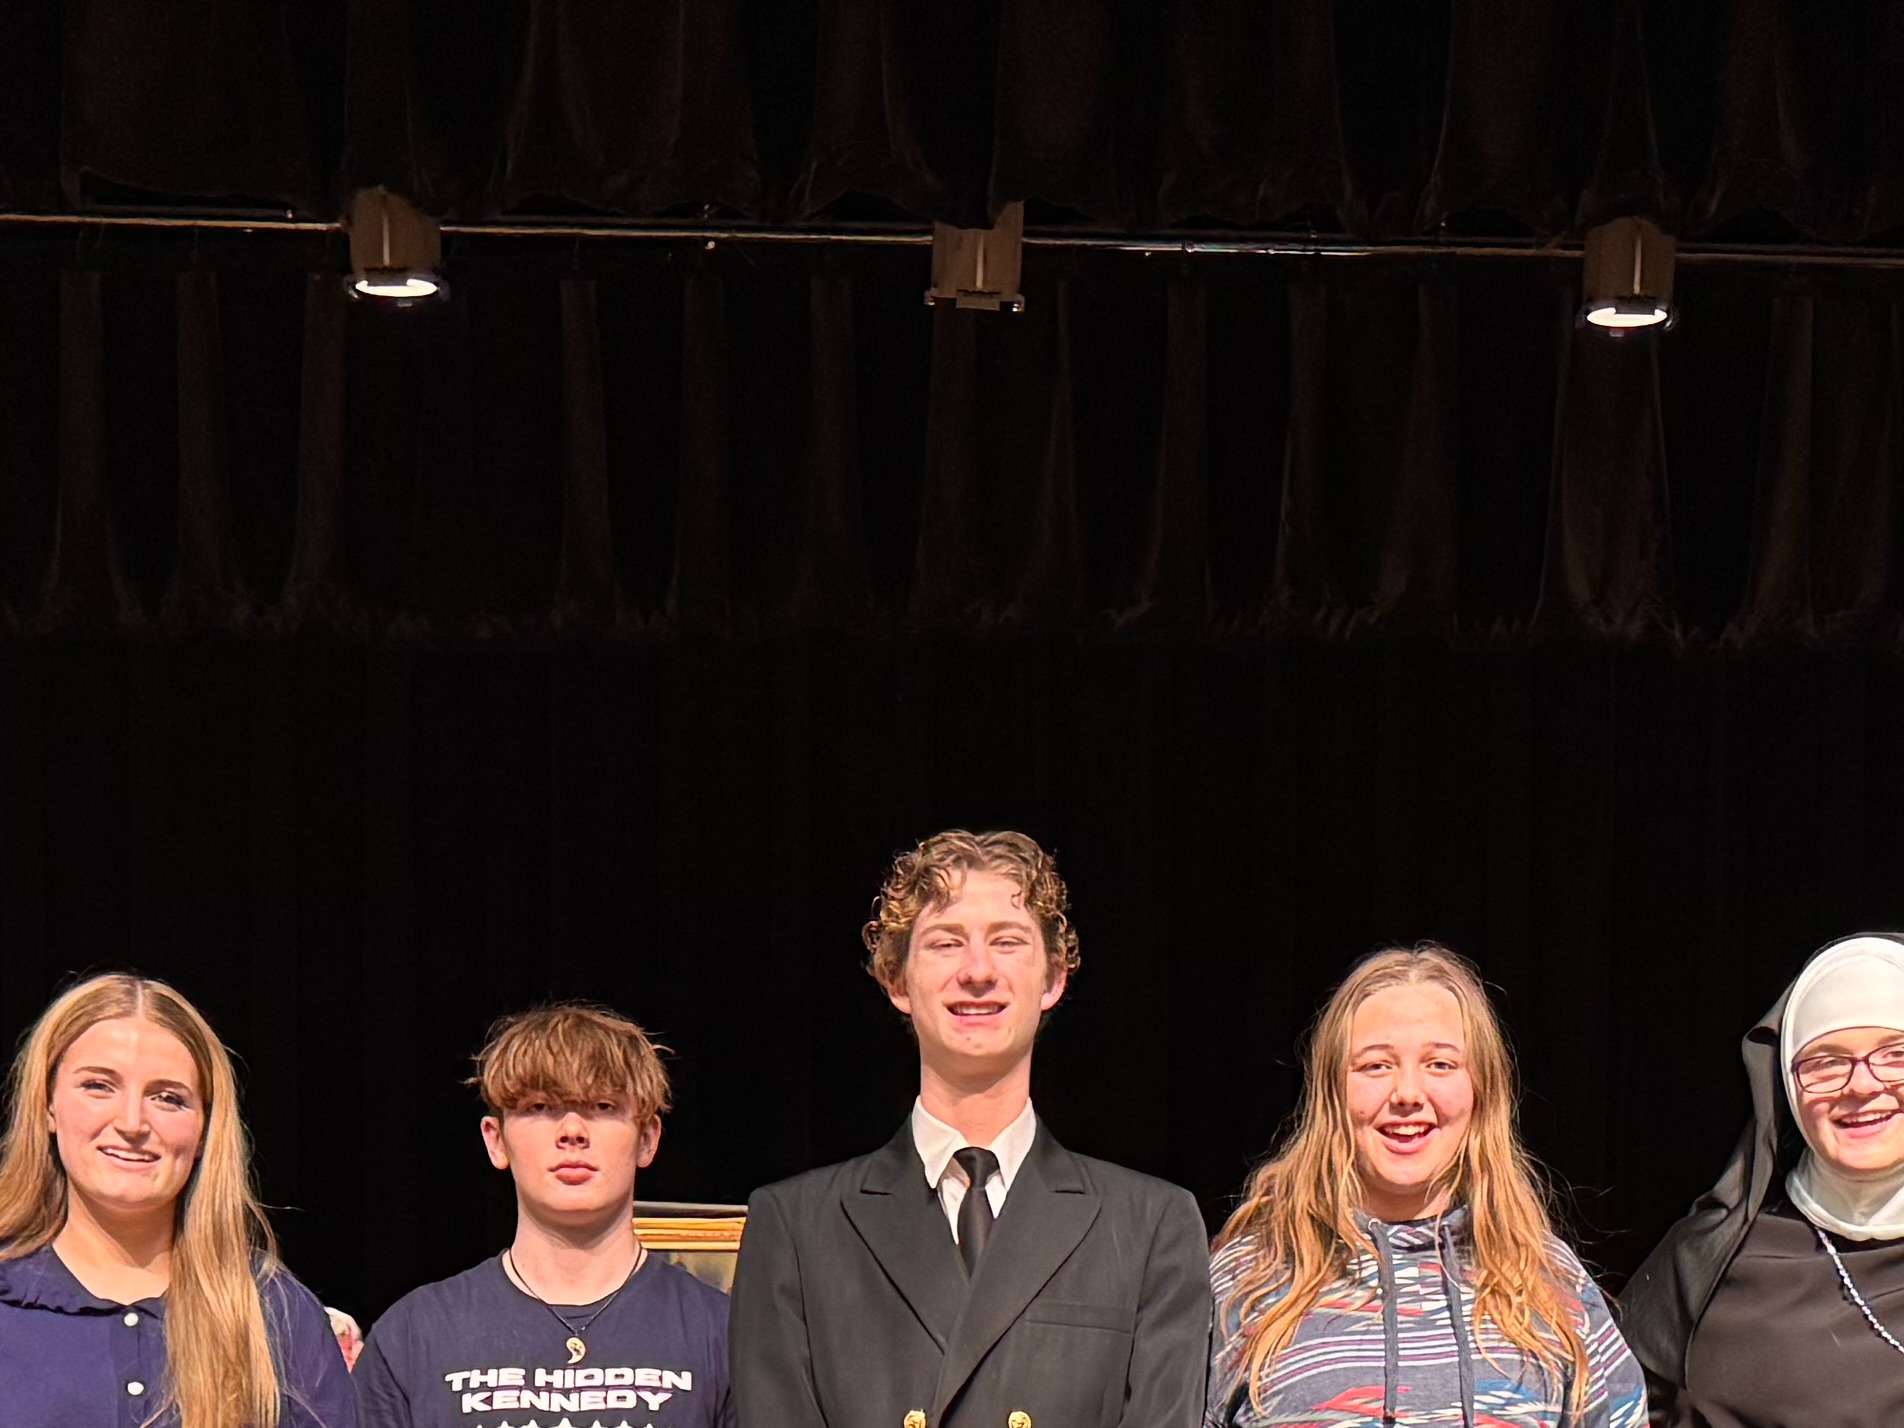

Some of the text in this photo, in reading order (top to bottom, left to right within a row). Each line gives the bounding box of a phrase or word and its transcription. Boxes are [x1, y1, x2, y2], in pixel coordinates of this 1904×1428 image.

[444, 1367, 693, 1392] THE HIDDEN
[461, 1389, 673, 1414] KENNEDY
